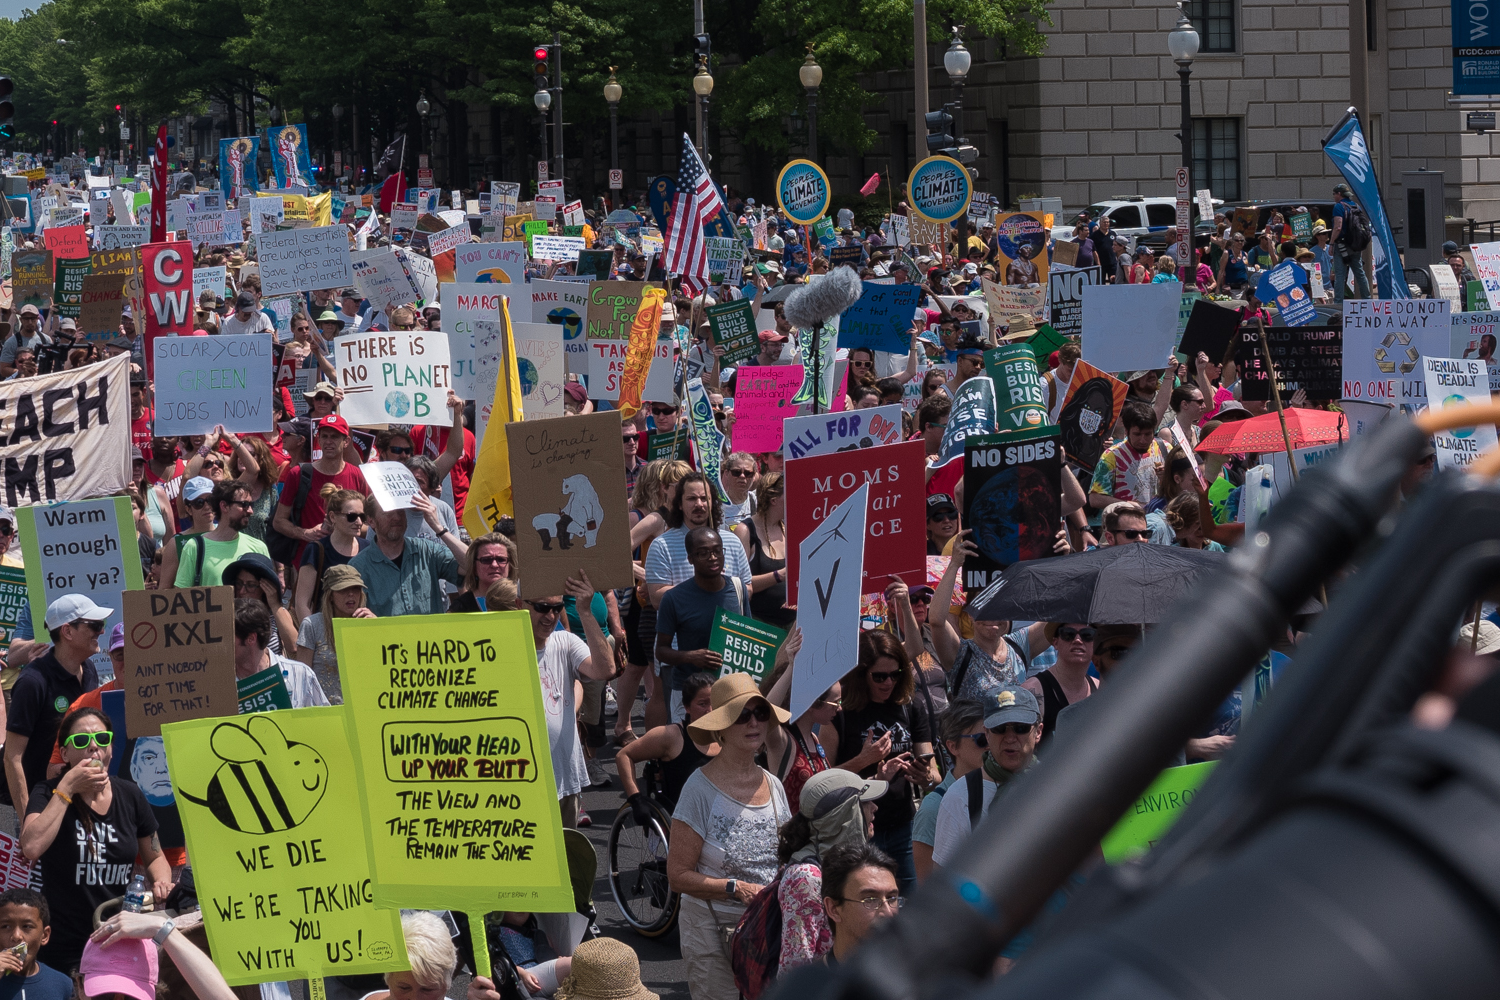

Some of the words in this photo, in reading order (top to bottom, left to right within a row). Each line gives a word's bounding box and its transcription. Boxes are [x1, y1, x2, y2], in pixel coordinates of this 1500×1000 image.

[786, 172, 813, 188] PEOPLES
[920, 169, 955, 183] PEOPLES
[783, 178, 824, 205] CLIMATE
[914, 177, 963, 201] CLIMATE
[790, 194, 825, 212] MOVEMENT
[920, 194, 965, 208] MOVEMENT
[259, 232, 298, 250] Federal
[302, 227, 346, 244] scientists
[262, 265, 287, 278] Save
[294, 259, 317, 273] jobs
[322, 253, 343, 267] and
[266, 281, 291, 291] save
[292, 275, 308, 287] the
[341, 336, 397, 362] THERE
[177, 368, 247, 390] GREEN
[343, 364, 367, 386] NO
[383, 364, 449, 387] PLANET
[1427, 360, 1464, 375] DENIAL
[1467, 363, 1479, 374] IS
[1344, 381, 1362, 397] NO
[1367, 381, 1395, 397] ONE
[1437, 375, 1477, 387] DEADLY
[161, 400, 210, 421] JOBS
[224, 397, 262, 417] NOW
[414, 392, 430, 417] B
[526, 426, 598, 456] Climate
[787, 429, 821, 458] ALL
[826, 416, 862, 441] FOR
[869, 414, 899, 445] ONE
[1436, 438, 1477, 451] CLIMATE
[531, 457, 545, 469] is
[546, 448, 592, 465] changing
[972, 450, 1003, 467] NO
[1005, 440, 1055, 465] SIDES
[44, 508, 106, 527] Warm
[43, 535, 117, 561] enough
[46, 572, 75, 590] for
[86, 566, 120, 591] ya?
[150, 587, 222, 617] DAPL
[164, 620, 223, 647] KXL
[416, 639, 470, 663] HARD
[473, 638, 496, 662] TO
[135, 664, 165, 678] AINT
[167, 659, 208, 675] NOBODY
[390, 667, 476, 688] RECOGNIZE
[138, 684, 162, 698] GOT
[166, 680, 196, 694] TIME
[378, 691, 437, 709] CLIMATE
[445, 690, 499, 709] CHANGE
[144, 701, 168, 716] FOR
[170, 695, 210, 711] THAT!
[390, 735, 431, 756] WITH
[431, 733, 471, 756] YOUR
[476, 735, 520, 756] HEAD
[401, 760, 424, 779] UP
[427, 758, 469, 780] YOUR
[474, 758, 530, 780] BUTT
[396, 791, 434, 813] THE
[436, 791, 479, 812] VIEW
[485, 793, 521, 810] AND
[75, 820, 118, 843] SAVE
[386, 818, 420, 838] THE
[424, 819, 537, 840] TEMPERATURE
[236, 845, 274, 873] WE
[286, 839, 326, 867] DIE
[406, 837, 459, 861] REMAIN
[463, 842, 490, 862] THE
[491, 843, 533, 862] SAME
[75, 864, 132, 885] FUTURE
[213, 892, 281, 922] WE'RE
[297, 879, 373, 915] TAKING
[289, 918, 321, 944] YOU
[237, 947, 295, 971] WITH
[326, 929, 363, 964] US!
